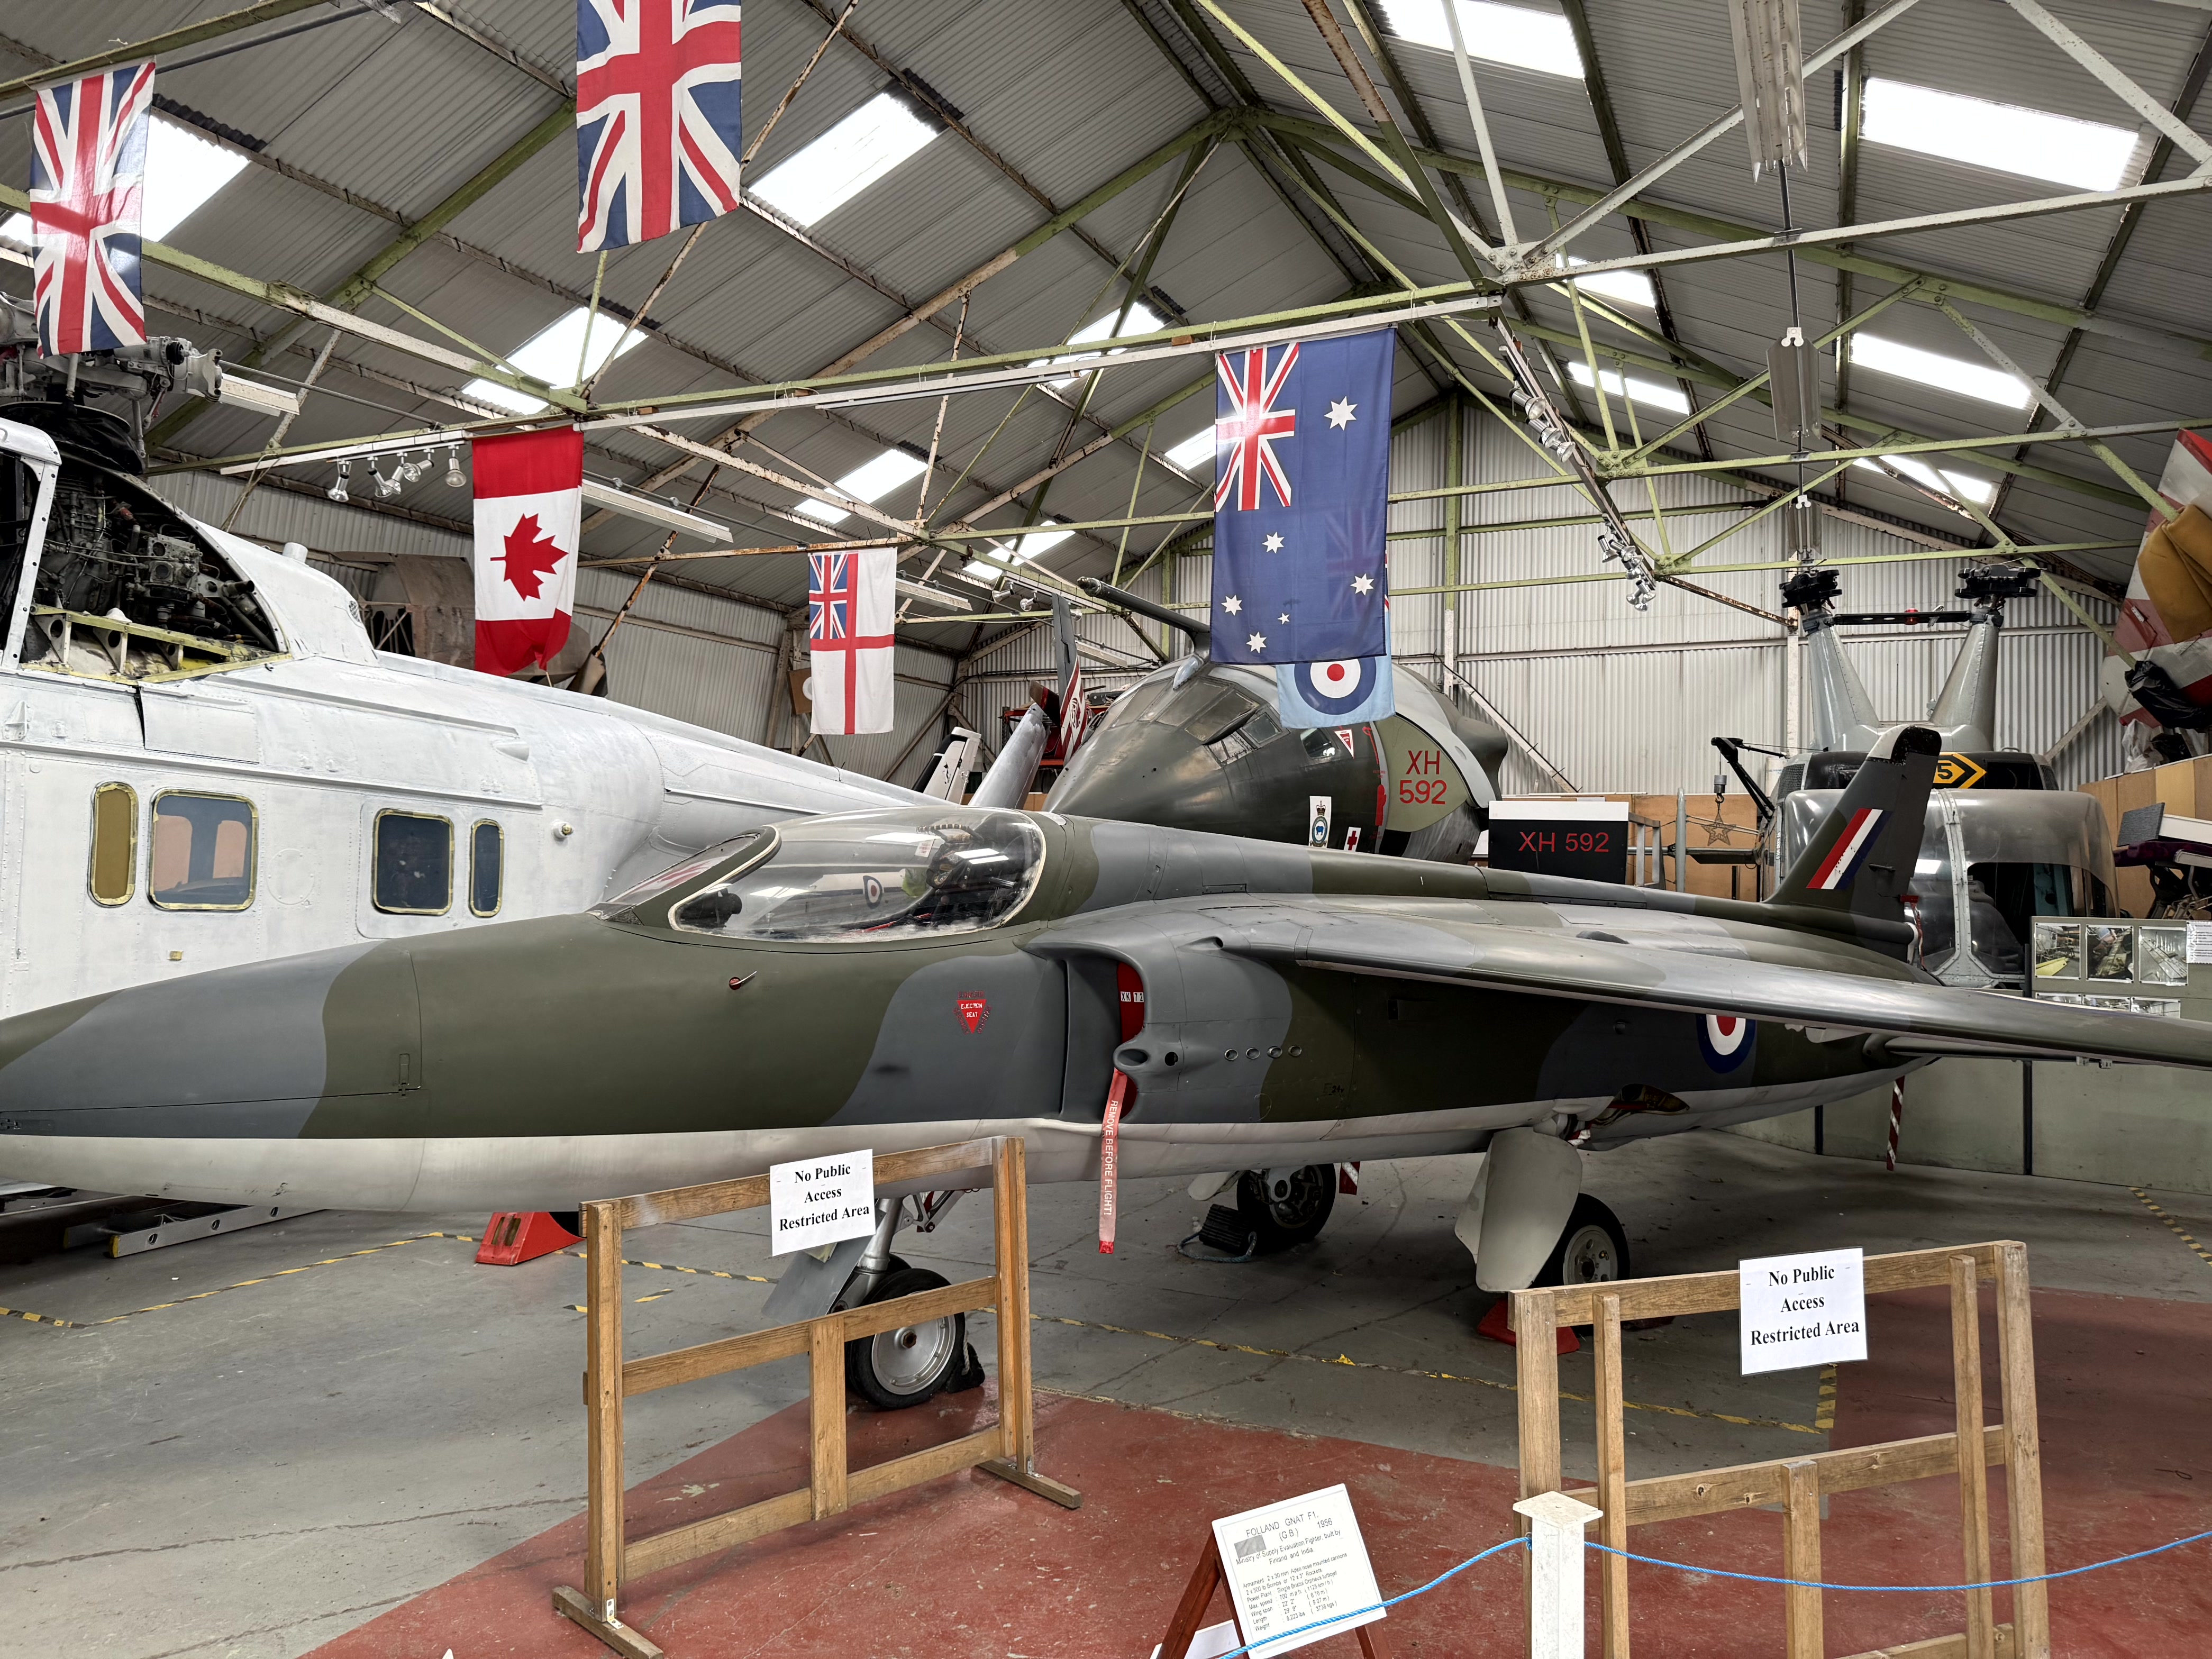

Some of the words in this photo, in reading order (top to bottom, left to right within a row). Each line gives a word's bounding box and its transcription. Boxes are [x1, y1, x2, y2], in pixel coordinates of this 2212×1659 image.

[1406, 750, 1440, 775] XH
[1937, 763, 1953, 779] 5
[1399, 779, 1447, 805] 592
[1518, 832, 1555, 852] XH
[1565, 832, 1609, 852] 592
[1121, 992, 1130, 1001] XK
[1105, 1100, 1118, 1136] REMOVE
[1105, 1138, 1113, 1177] BEFORE
[794, 1170, 811, 1183] No
[815, 1164, 851, 1179] Public
[804, 1188, 842, 1203] Access
[1104, 1179, 1112, 1215] FLIGHT!
[779, 1209, 838, 1231] Restricted
[842, 1206, 869, 1219] Area
[1769, 1271, 1788, 1287] No
[1792, 1265, 1835, 1283] Public
[1780, 1297, 1825, 1312] Access
[1750, 1323, 1820, 1346] Restricted
[1825, 1320, 1859, 1335] Area
[1245, 1521, 1280, 1537] FOLLAND
[1285, 1514, 1304, 1526] GNAT
[1317, 1518, 1332, 1528] 1956
[1235, 1556, 1254, 1565] Ministry
[1261, 1548, 1279, 1557] Supply
[1279, 1540, 1305, 1552] Evaluation
[1269, 1554, 1288, 1565] Finland
[1243, 1578, 1264, 1588] Armament
[1313, 1557, 1330, 1567] mounted
[1331, 1553, 1347, 1561] cannons
[1304, 1576, 1322, 1584] Orpheus
[1322, 1570, 1337, 1579] turbojet
[1260, 1598, 1272, 1607] speed
[1253, 1616, 1267, 1625] Length
[1254, 1622, 1270, 1631] Weight
